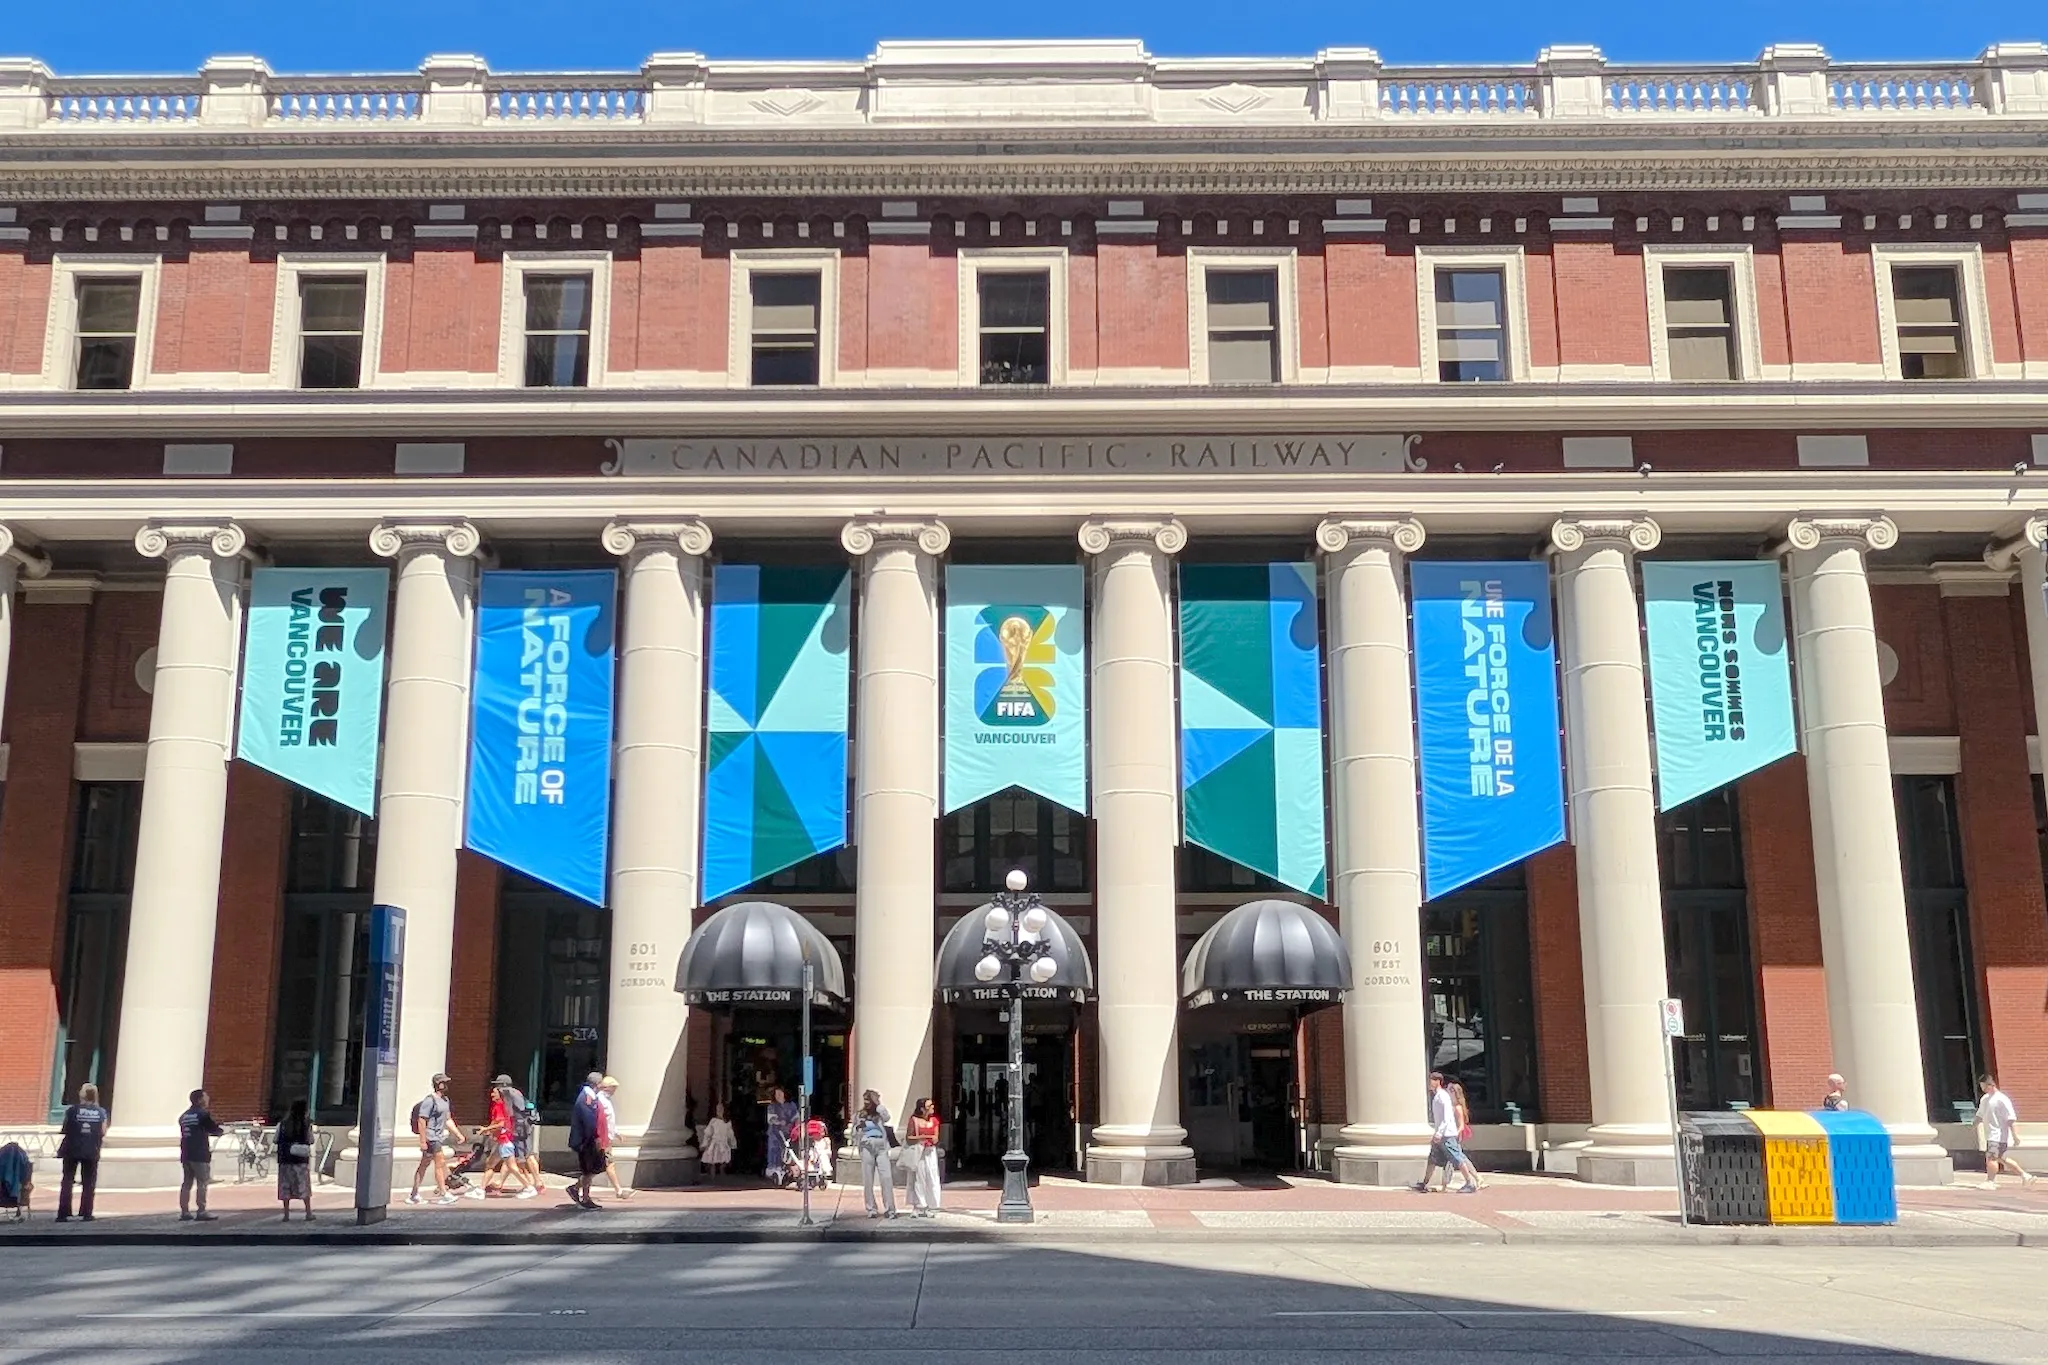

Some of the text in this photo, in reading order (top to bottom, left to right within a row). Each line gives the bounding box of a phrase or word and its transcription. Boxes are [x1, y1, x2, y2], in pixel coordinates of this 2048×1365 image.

[672, 440, 1356, 470] CANADIAN PACIFIC RAILWAY
[280, 587, 314, 747] VANCOUVER
[308, 587, 348, 747] WE ARE
[1692, 580, 1726, 742] VANCOUVER
[1716, 580, 1746, 742] NOUS SOMMES
[514, 588, 545, 805] NATURE
[541, 588, 572, 805] A FORCE OF
[1459, 580, 1494, 797] NATURE
[1484, 580, 1515, 797] UNE FORCE DE LA
[996, 701, 1036, 717] FIFA
[973, 732, 1057, 745] VANCOUVER
[630, 943, 657, 955] 601
[1373, 941, 1400, 954] 601
[628, 961, 657, 971] WEST
[1372, 960, 1401, 969] WEST
[1364, 976, 1411, 986] CORDOVA
[706, 990, 791, 1002] THE STATION
[973, 988, 999, 999] THE
[1244, 989, 1330, 1001] THE STATION
